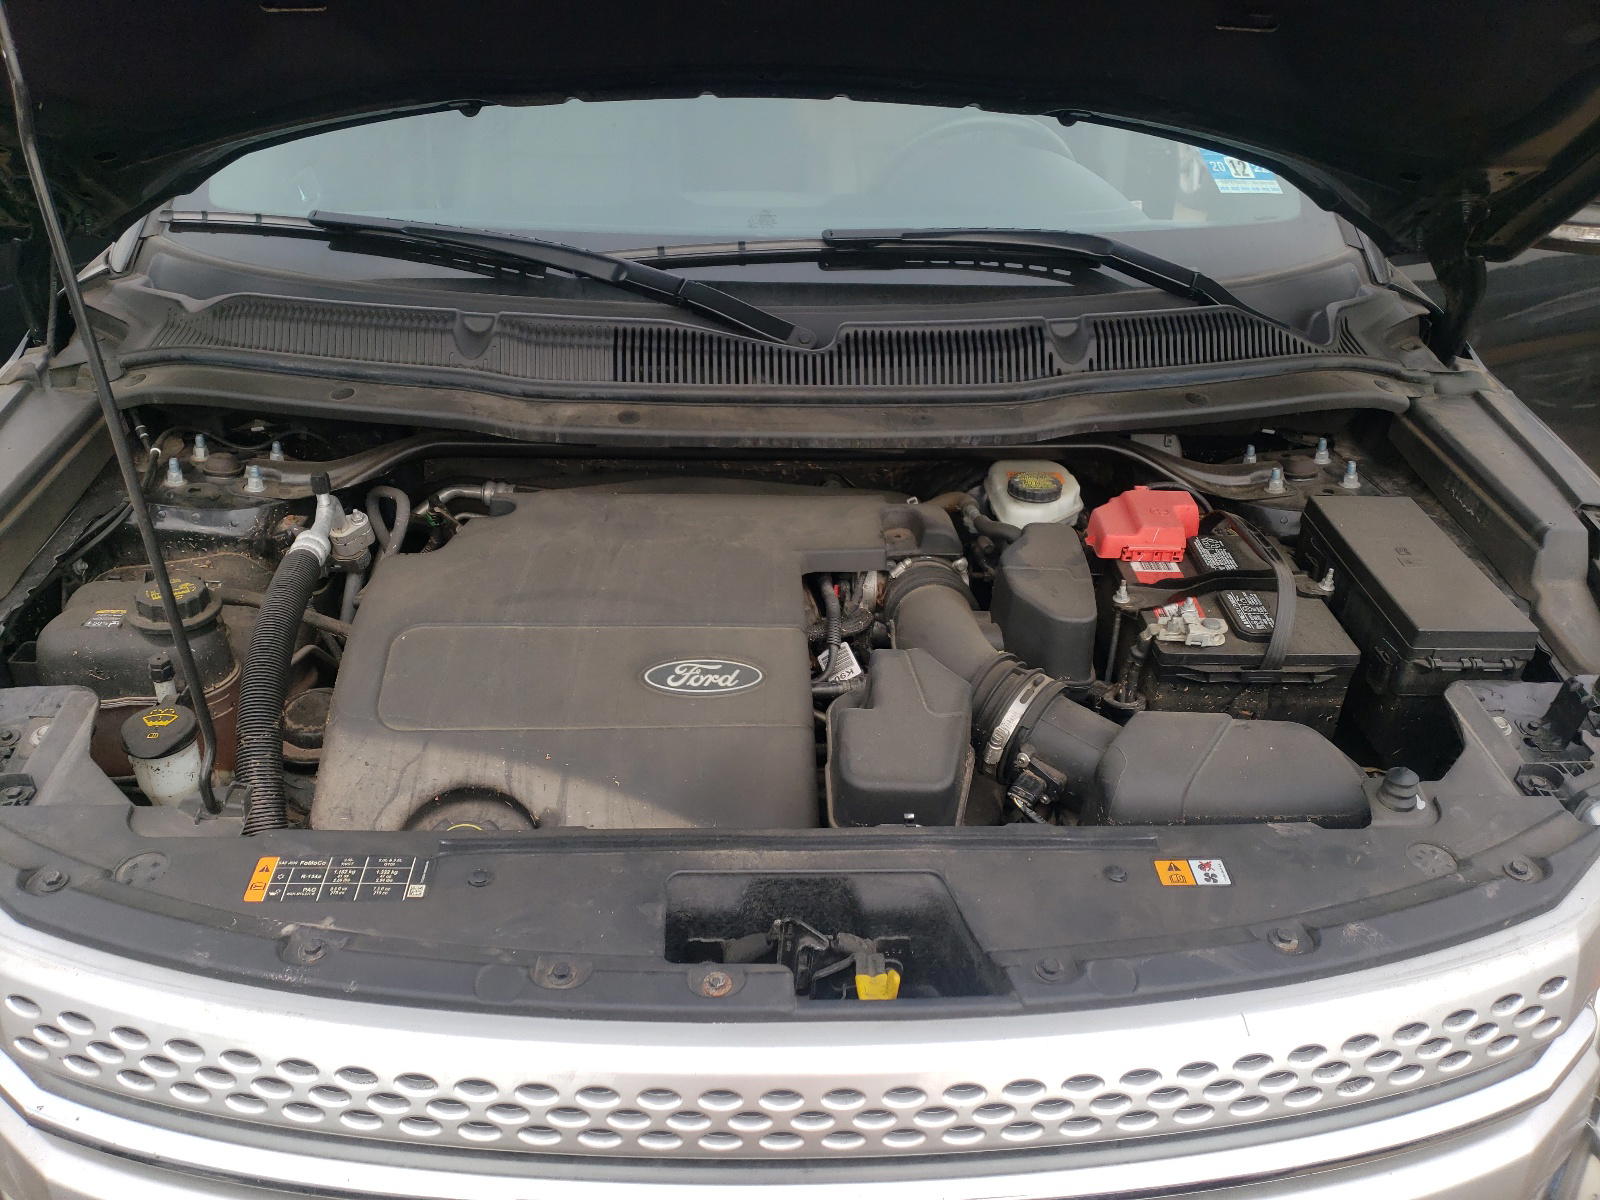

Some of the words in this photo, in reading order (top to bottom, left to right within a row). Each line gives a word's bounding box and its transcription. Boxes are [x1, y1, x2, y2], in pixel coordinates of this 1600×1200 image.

[1210, 161, 1225, 172] 20
[1229, 160, 1250, 177] 12
[667, 663, 740, 687] Ford
